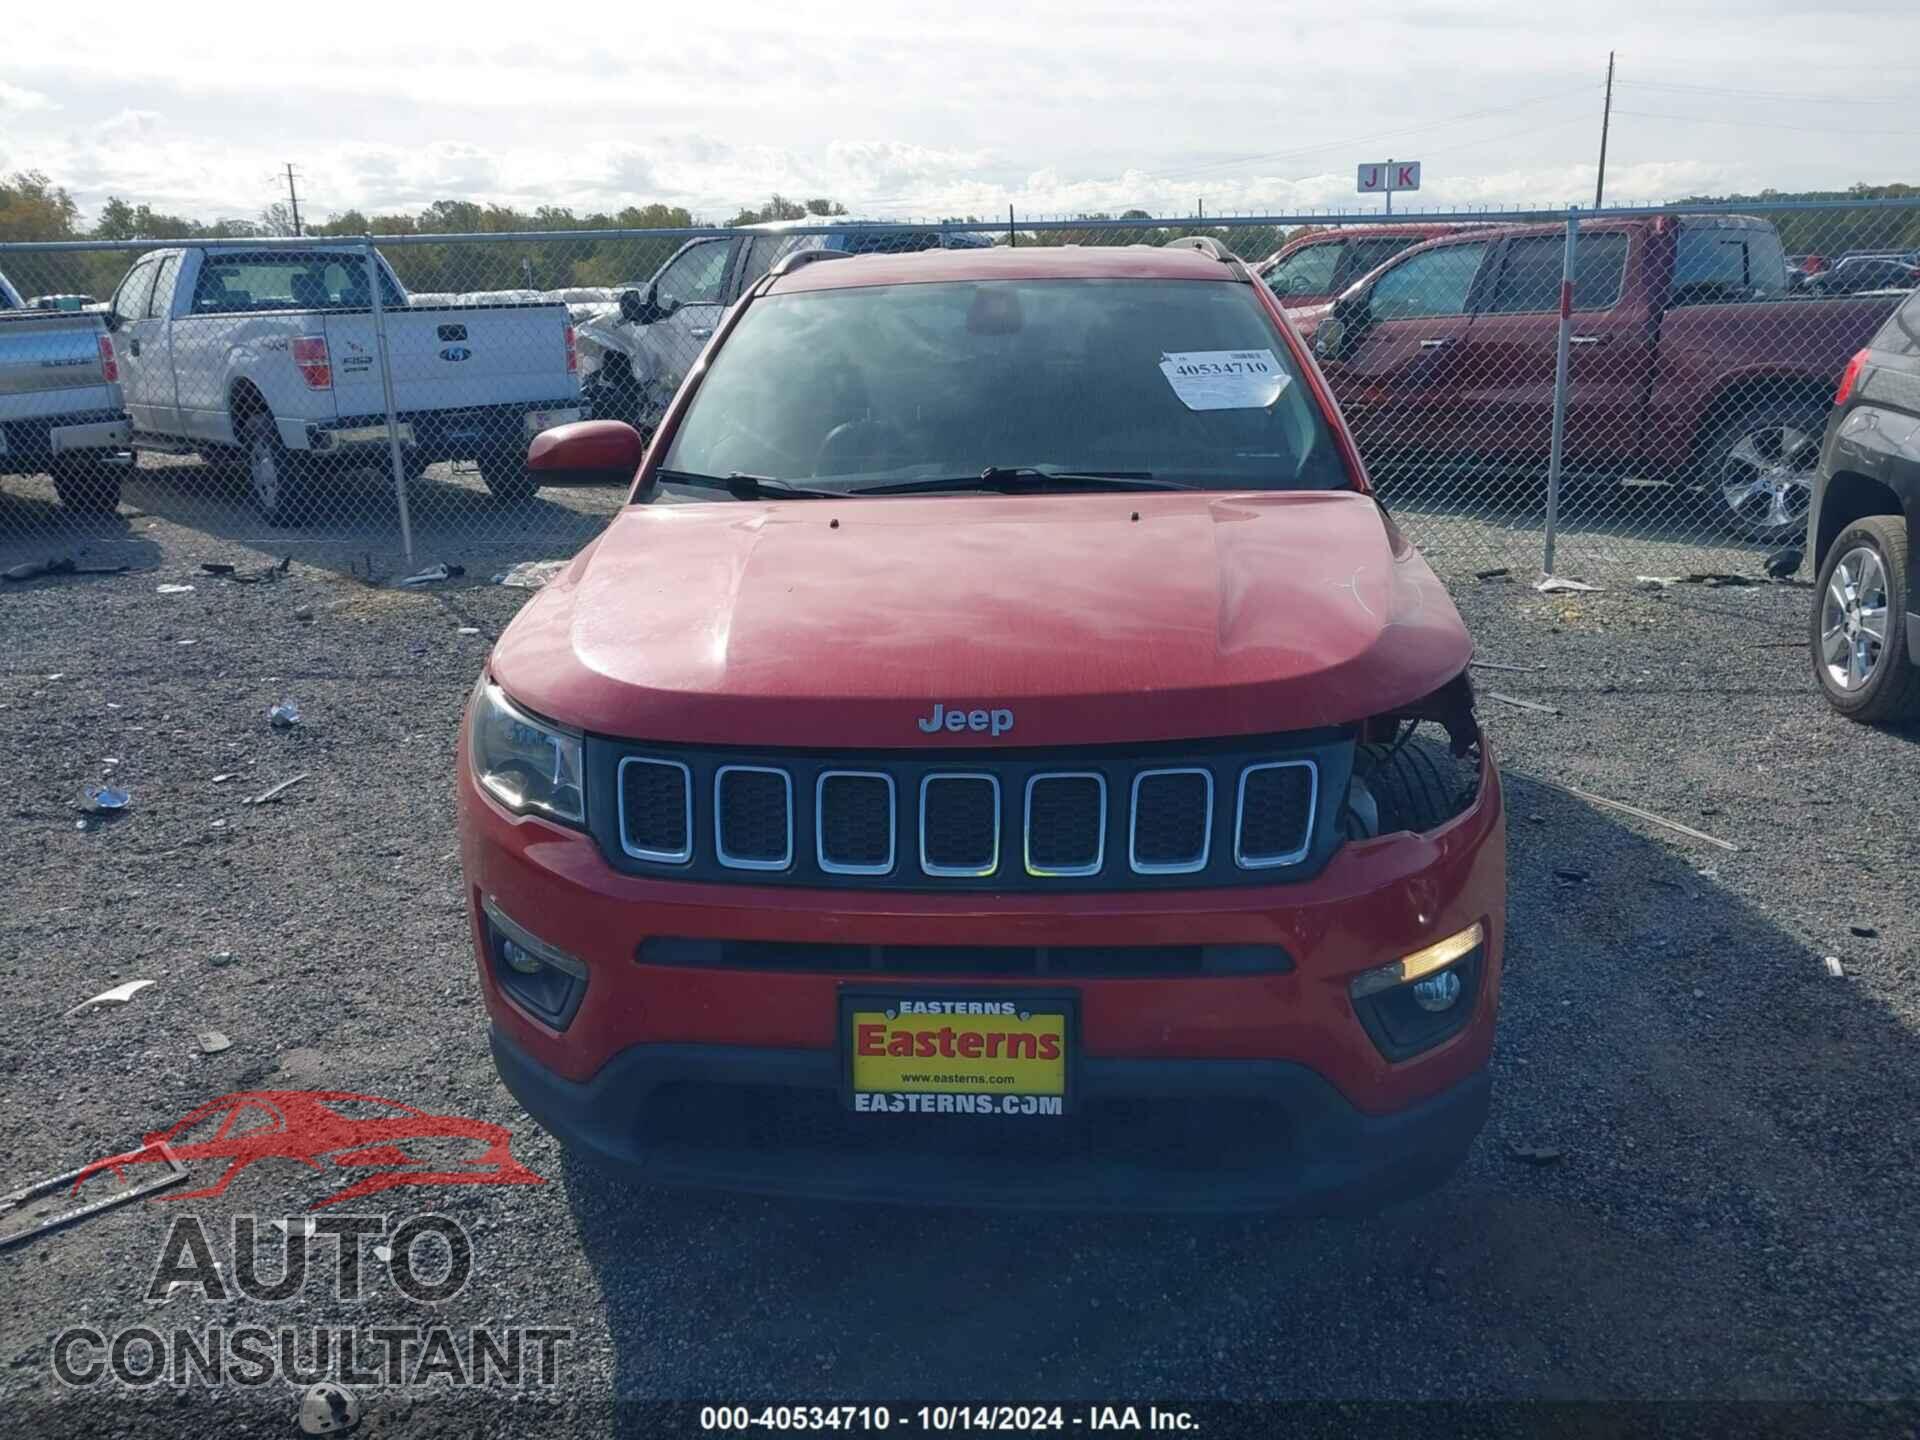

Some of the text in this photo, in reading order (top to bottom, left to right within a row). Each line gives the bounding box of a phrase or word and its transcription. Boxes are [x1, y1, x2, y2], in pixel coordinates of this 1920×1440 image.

[1364, 167, 1377, 188] J
[1398, 165, 1415, 187] K
[1176, 362, 1269, 376] 40534710
[918, 703, 1015, 736] Jeep
[899, 1001, 1016, 1015] EASTERNS
[857, 1023, 1061, 1060] Easterns
[901, 1073, 1015, 1085] www.easterns.com
[855, 1093, 1063, 1115] EASTERNS.COM
